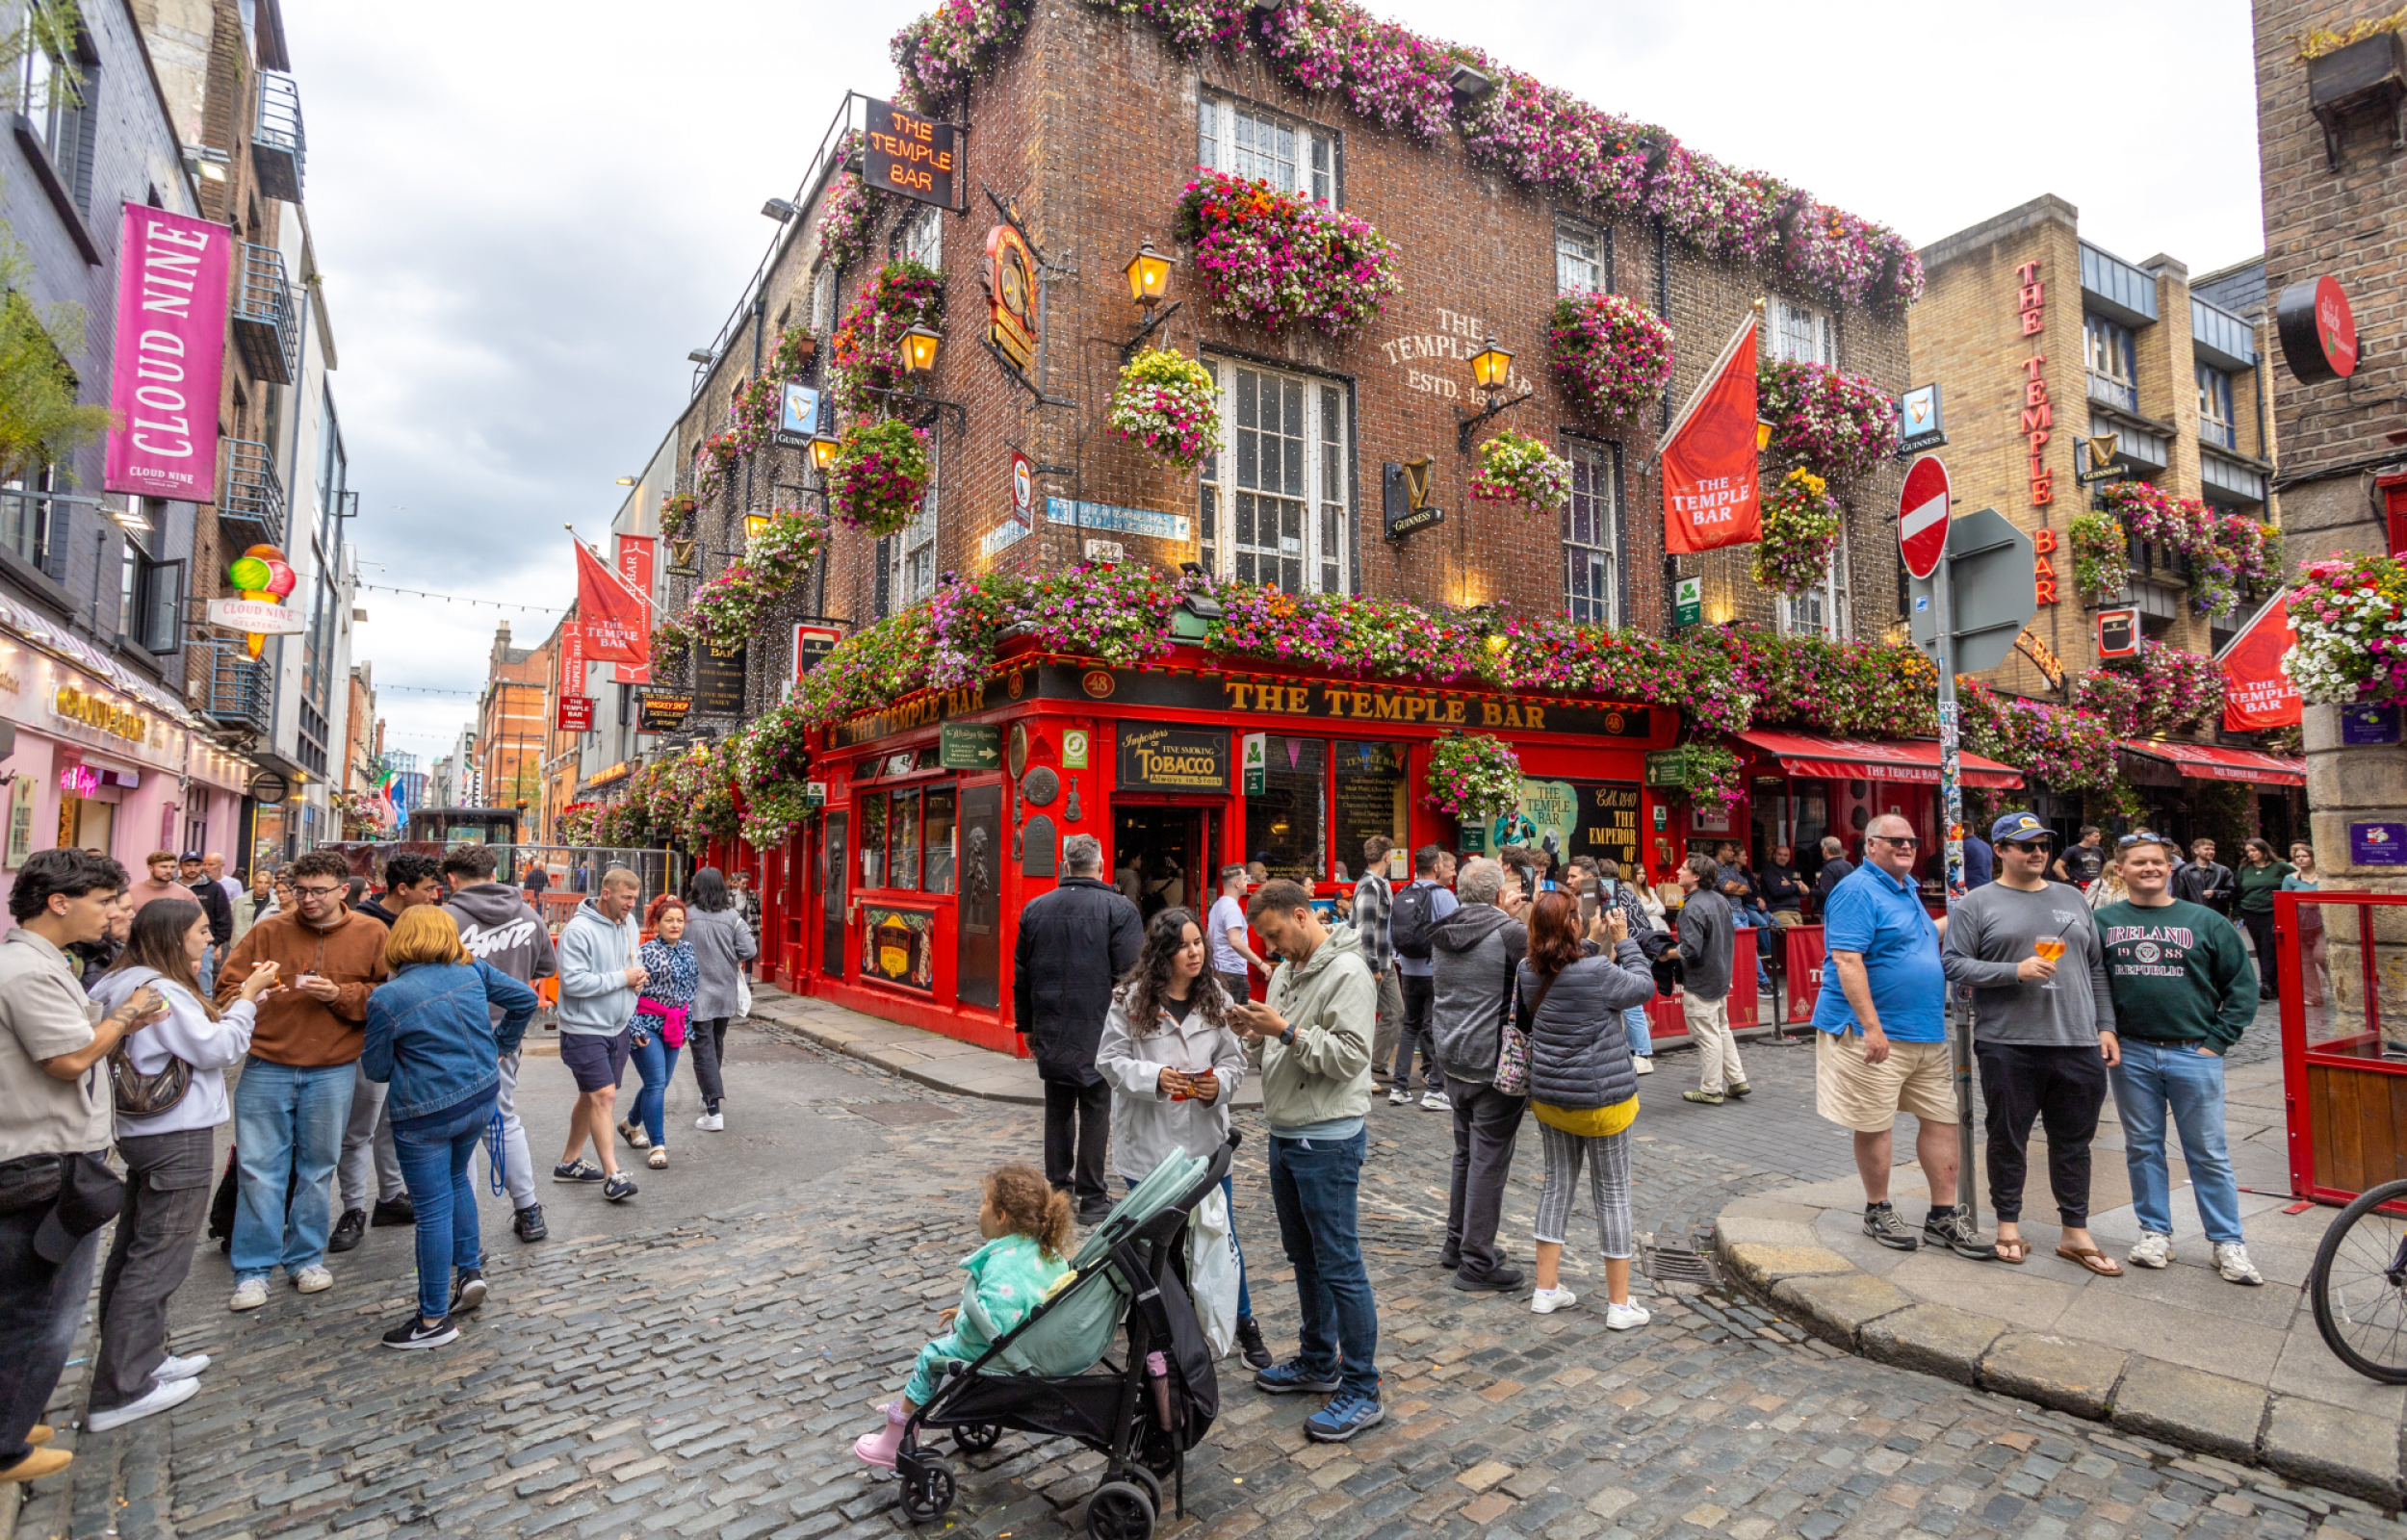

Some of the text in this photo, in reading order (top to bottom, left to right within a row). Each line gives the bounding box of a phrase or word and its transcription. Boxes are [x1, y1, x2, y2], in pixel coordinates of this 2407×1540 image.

[892, 112, 933, 141] THE
[870, 131, 951, 170] TEMPLE
[891, 164, 932, 192] BAR
[1436, 307, 1483, 340] THE
[134, 220, 209, 457] CLOUD NINE
[1382, 335, 1479, 365] TEMPLE
[1409, 369, 1508, 406] ESTD. 180
[778, 433, 809, 446] GUINN
[2015, 259, 2060, 606] THE TEMPLE BAR
[1902, 435, 1941, 451] GUINNESS
[129, 466, 194, 484] CLOUD NINE
[2083, 467, 2122, 480] GUINNESS
[1695, 476, 1729, 493] THE
[1670, 484, 1749, 511] TEMPLE
[1395, 510, 1431, 530] GUINNESS
[1693, 506, 1732, 526] BAR
[222, 603, 294, 622] CLOUD NINE
[232, 619, 281, 630] GELATERIA
[602, 620, 623, 629] THE
[585, 627, 639, 641] TEMPLE
[600, 638, 628, 649] BAR
[710, 647, 735, 658] BAR
[2032, 636, 2062, 685] BAR
[1087, 675, 1107, 690] 48
[2246, 680, 2276, 691] THE
[2228, 685, 2299, 704] TEMPLE
[645, 700, 690, 710] WHISKEY SHOP
[1225, 681, 1545, 730] THE TEMPLE BAR
[2245, 699, 2283, 713] BAR
[851, 688, 985, 743] THE TEMPLE BAR
[1122, 729, 1169, 748] Importers
[1162, 745, 1214, 756] FINE SMOKING
[1134, 749, 1215, 780] TOBACCO
[1866, 765, 1940, 781] THE TEMPLE BAR
[1151, 775, 1182, 783] Always
[2226, 768, 2247, 779] TEMPLE
[2247, 771, 2259, 780] BAR
[1537, 786, 1561, 800] THE
[1525, 798, 1571, 813] TEMPLE
[1538, 811, 1561, 826] BAR
[1613, 810, 1636, 829] THE
[1589, 827, 1637, 845] EMPEROR
[1623, 846, 1637, 862] OF
[2105, 925, 2193, 950] IRELAND
[2117, 947, 2184, 959] 19 88
[2114, 963, 2185, 977] REPUBLIC
